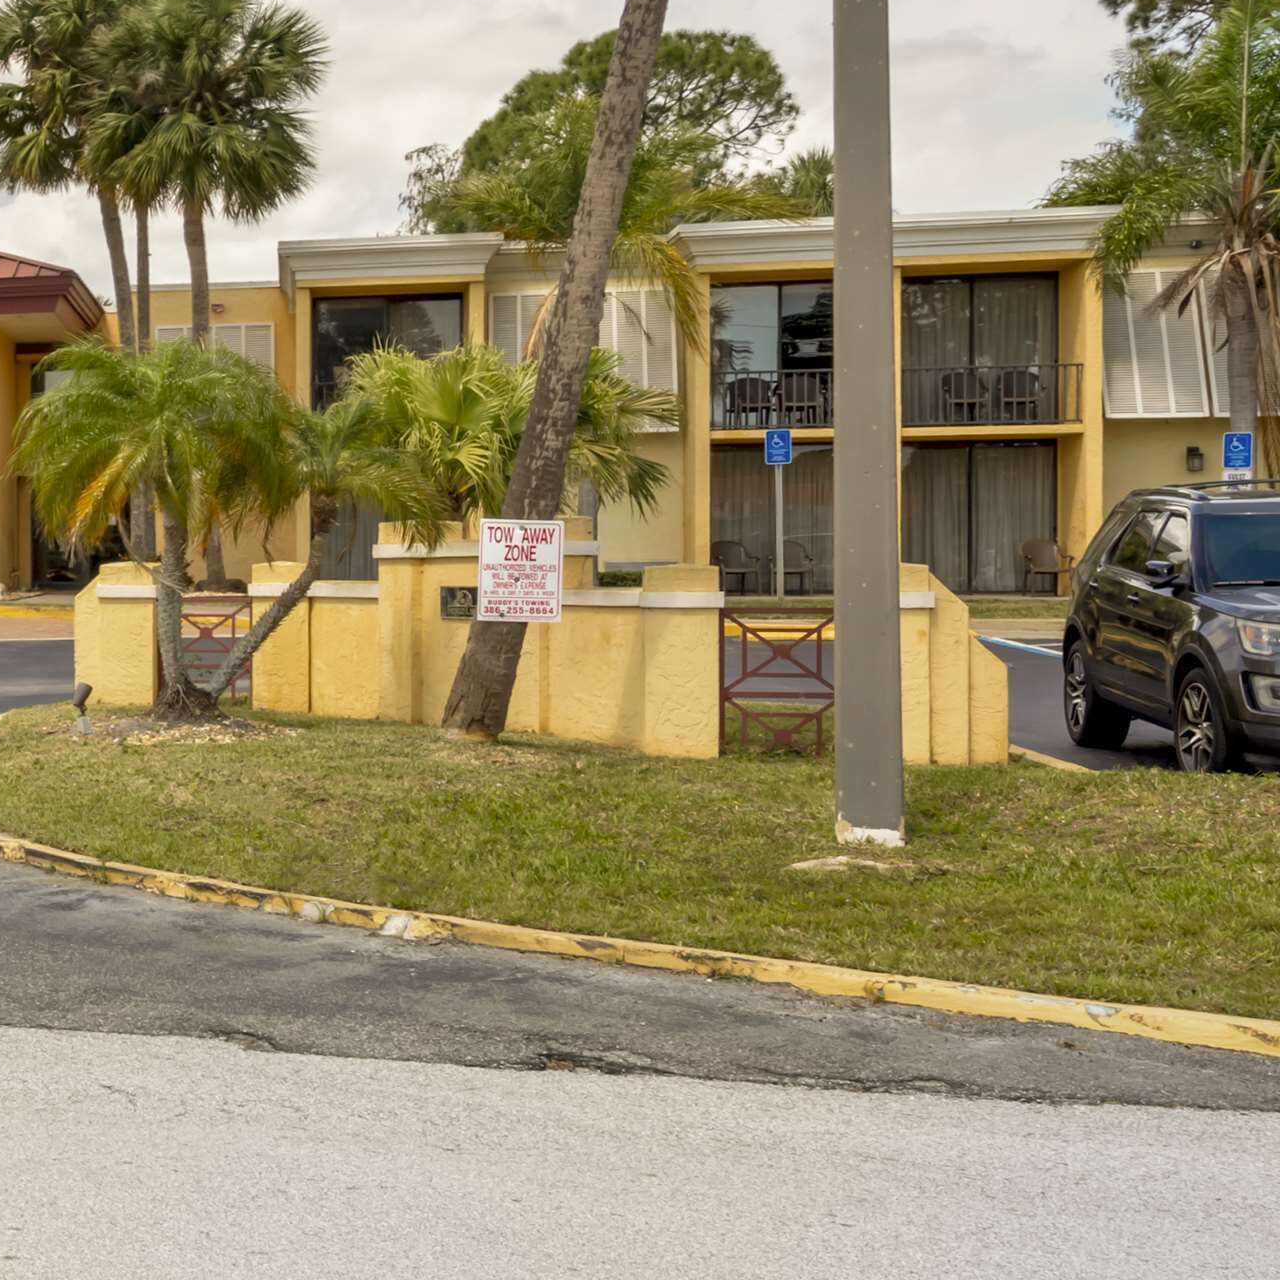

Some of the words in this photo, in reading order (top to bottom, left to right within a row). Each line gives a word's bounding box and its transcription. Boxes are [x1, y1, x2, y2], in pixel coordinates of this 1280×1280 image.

[487, 526, 515, 544] TOW
[521, 527, 556, 545] AWAY
[504, 544, 537, 562] ZONE
[483, 563, 527, 572] UNAUTHORIZED
[529, 564, 557, 573] VEHICLES
[491, 572, 505, 581] WILL
[518, 573, 538, 581] TOWED
[540, 573, 548, 581] AT
[493, 581, 518, 590] OWNER'S
[520, 582, 547, 590] EXPENSE
